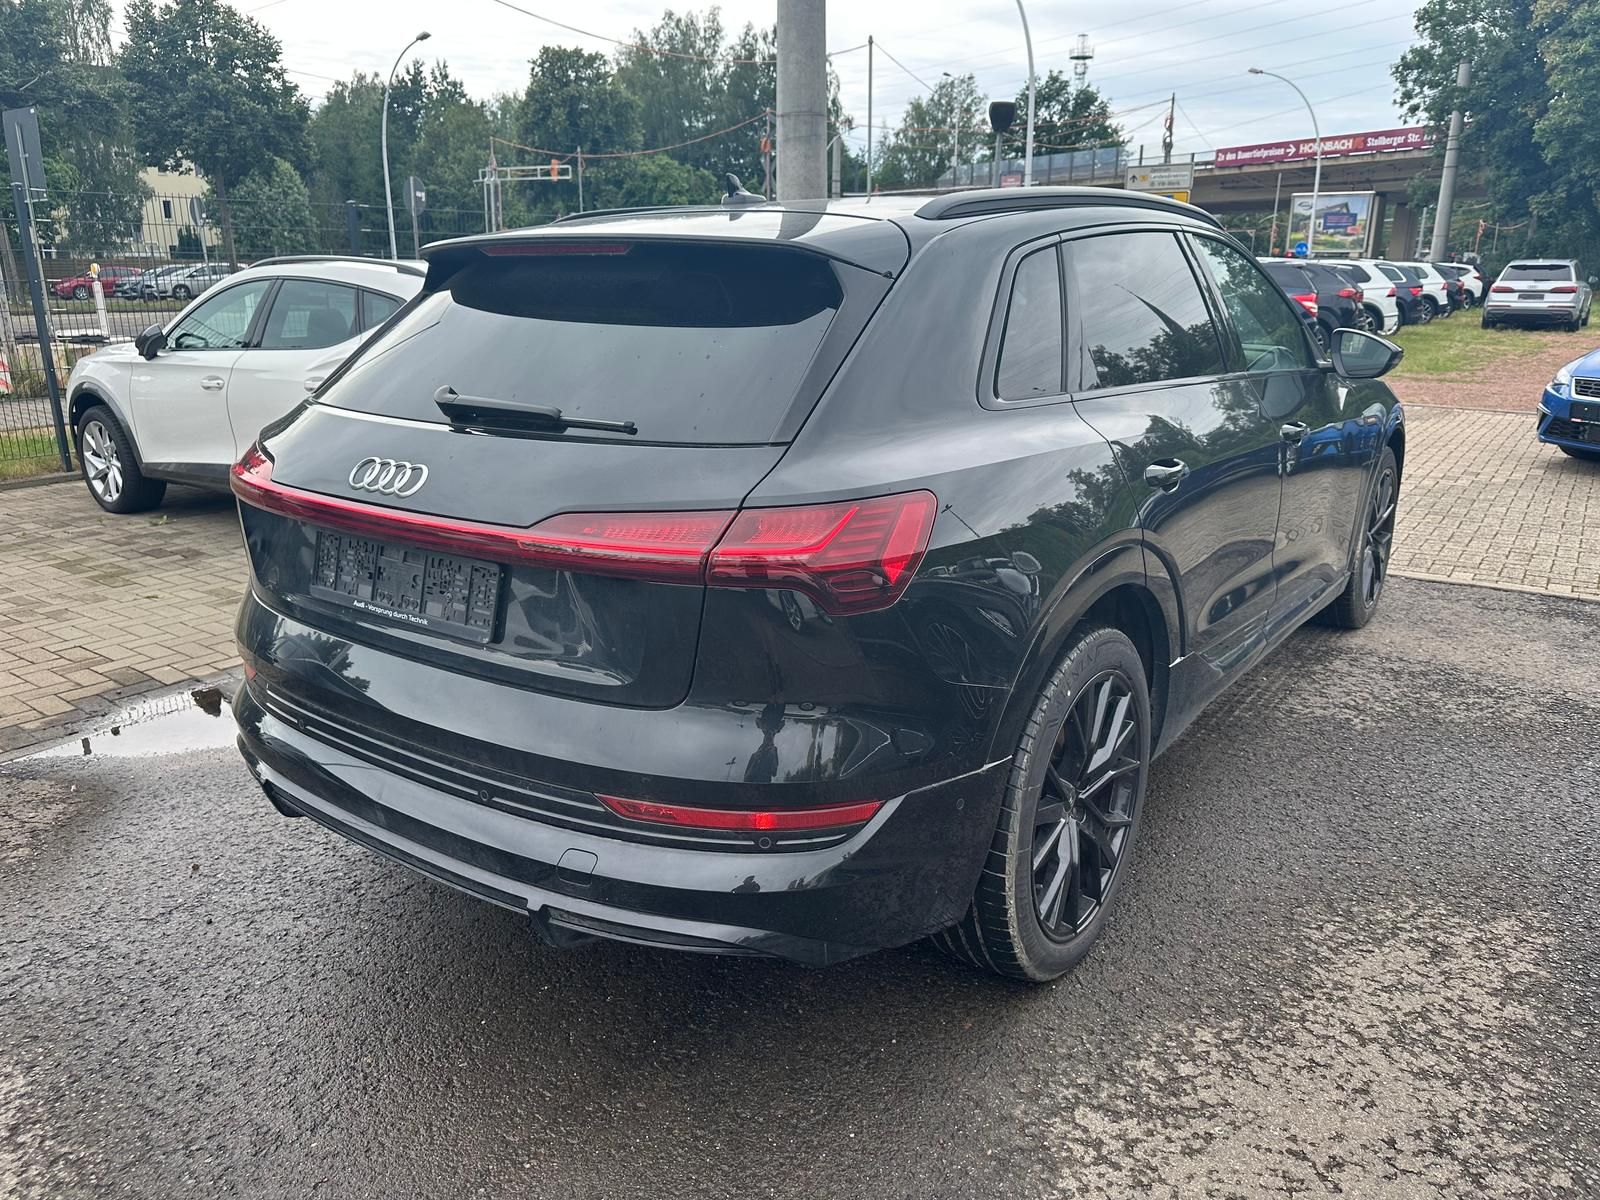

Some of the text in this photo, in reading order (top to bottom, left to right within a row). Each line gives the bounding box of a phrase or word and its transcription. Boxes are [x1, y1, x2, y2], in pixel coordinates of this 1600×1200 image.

[1226, 151, 1236, 160] den
[1407, 132, 1421, 142] Str.
[353, 599, 365, 607] Audi
[368, 604, 393, 617] Vorsprung
[393, 611, 408, 620] durch
[408, 614, 429, 625] Technik
